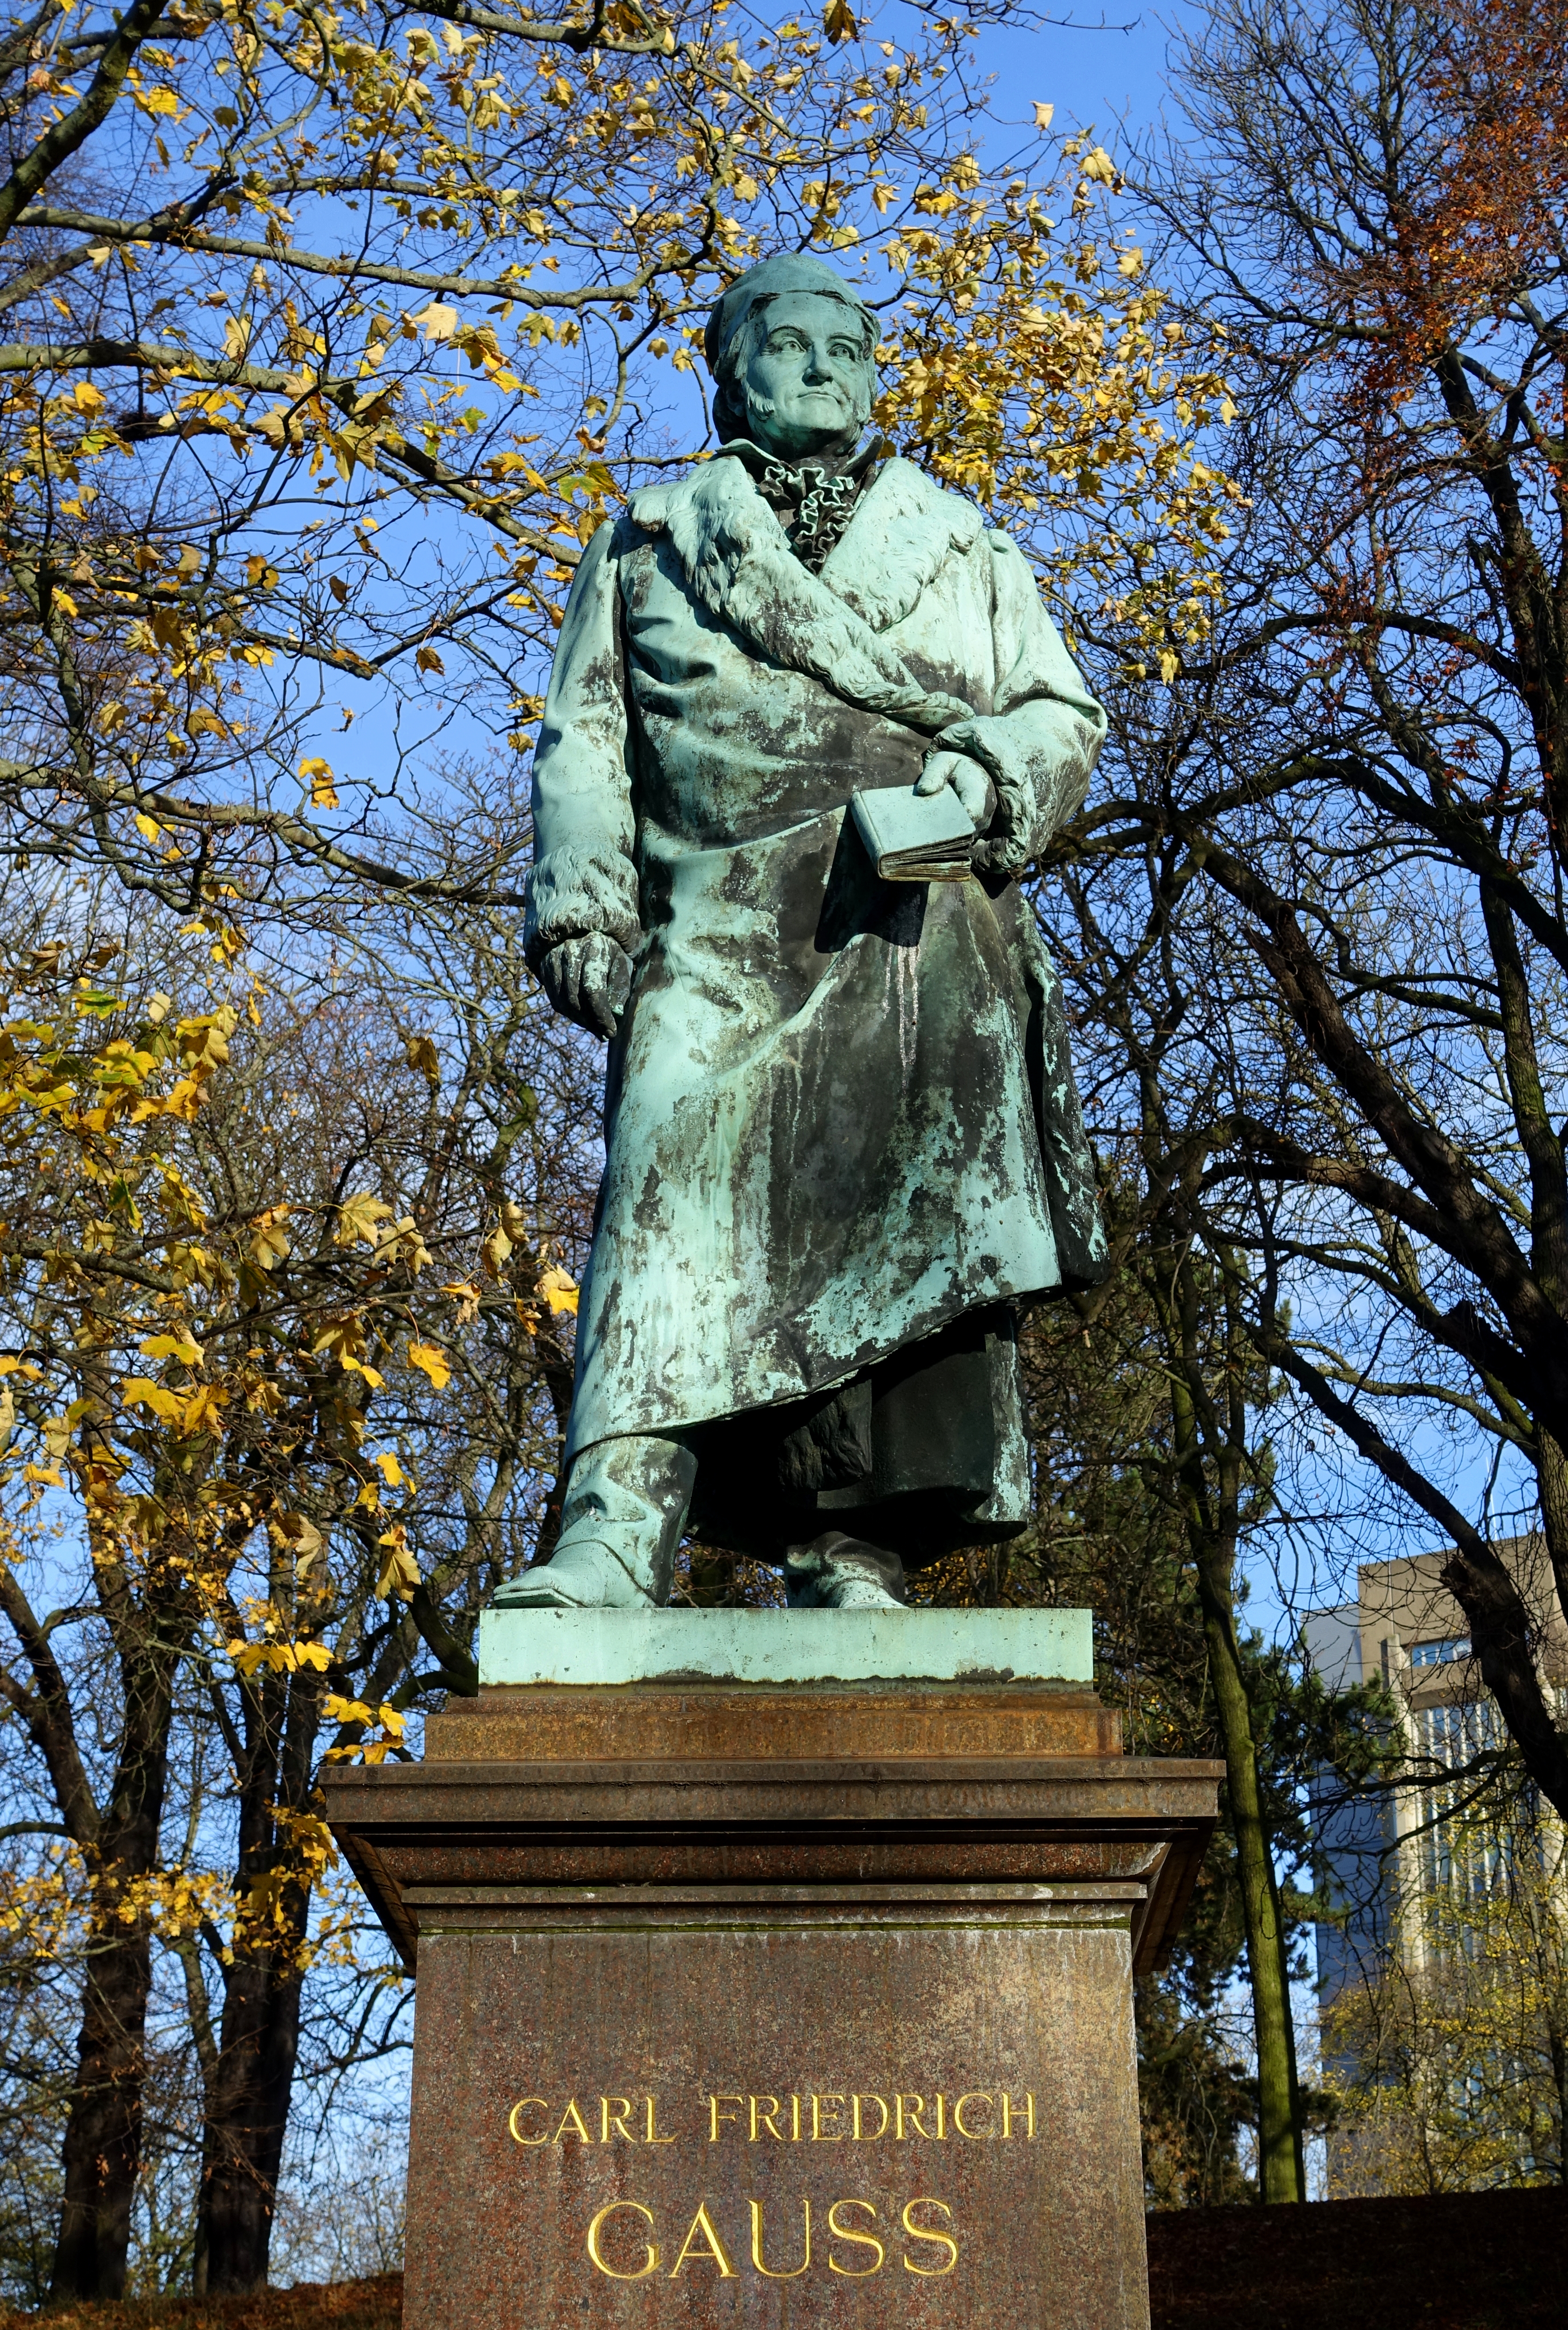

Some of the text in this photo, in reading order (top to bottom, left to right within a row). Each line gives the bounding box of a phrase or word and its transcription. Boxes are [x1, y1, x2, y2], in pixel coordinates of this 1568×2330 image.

[509, 2091, 1037, 2145] CARL FRIEDRICH
[587, 2198, 958, 2279] GAUSS
